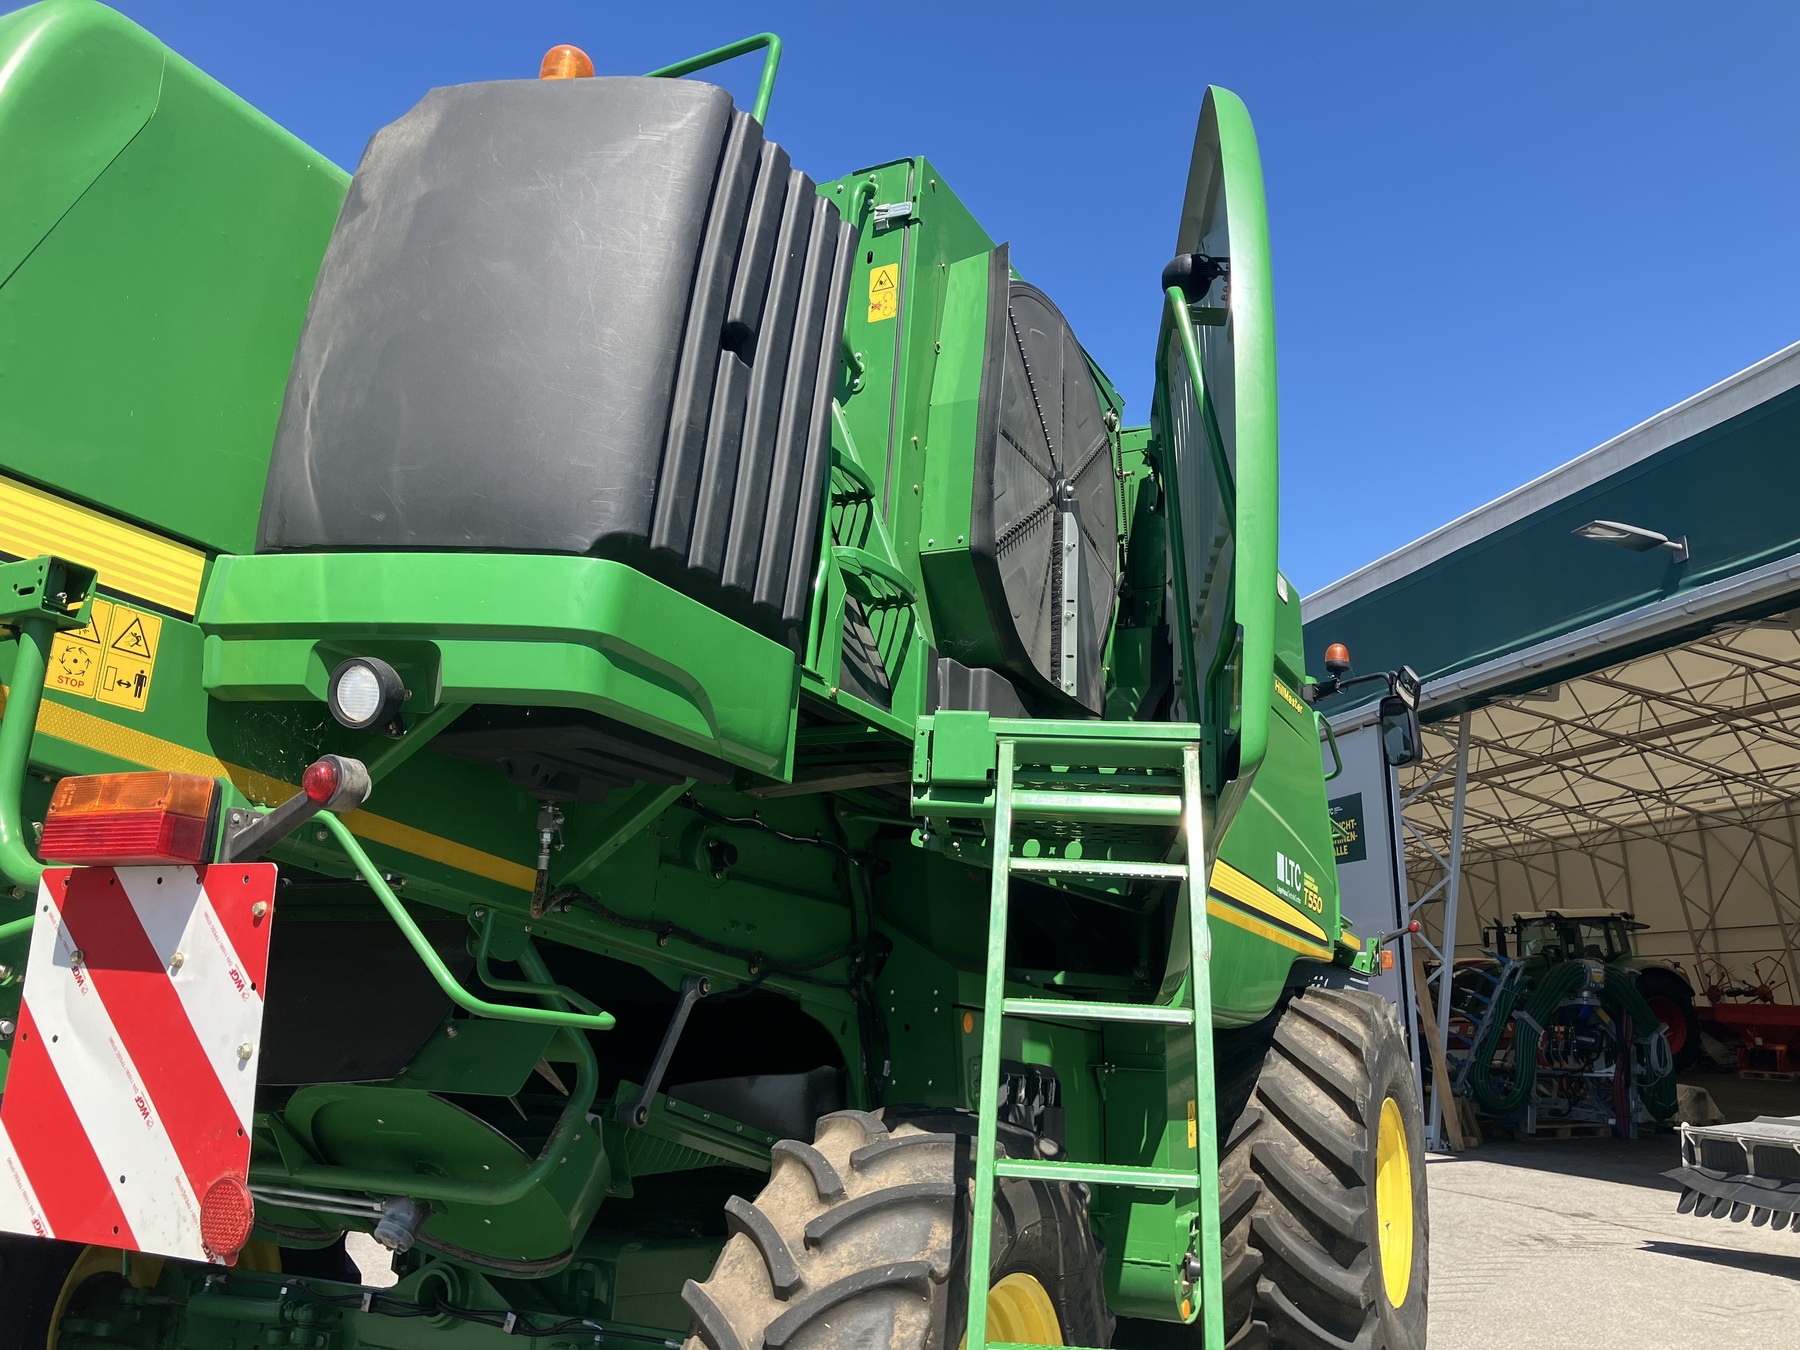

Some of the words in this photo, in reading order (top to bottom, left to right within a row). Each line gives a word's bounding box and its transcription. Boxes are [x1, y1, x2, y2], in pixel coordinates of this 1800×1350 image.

[57, 675, 85, 688] STOP
[1275, 680, 1303, 715] HillMaster
[1285, 856, 1301, 892] LTC
[1303, 887, 1323, 914] T550
[71, 965, 84, 987] WGF
[229, 968, 245, 992] WGF
[135, 1095, 149, 1120] WGF
